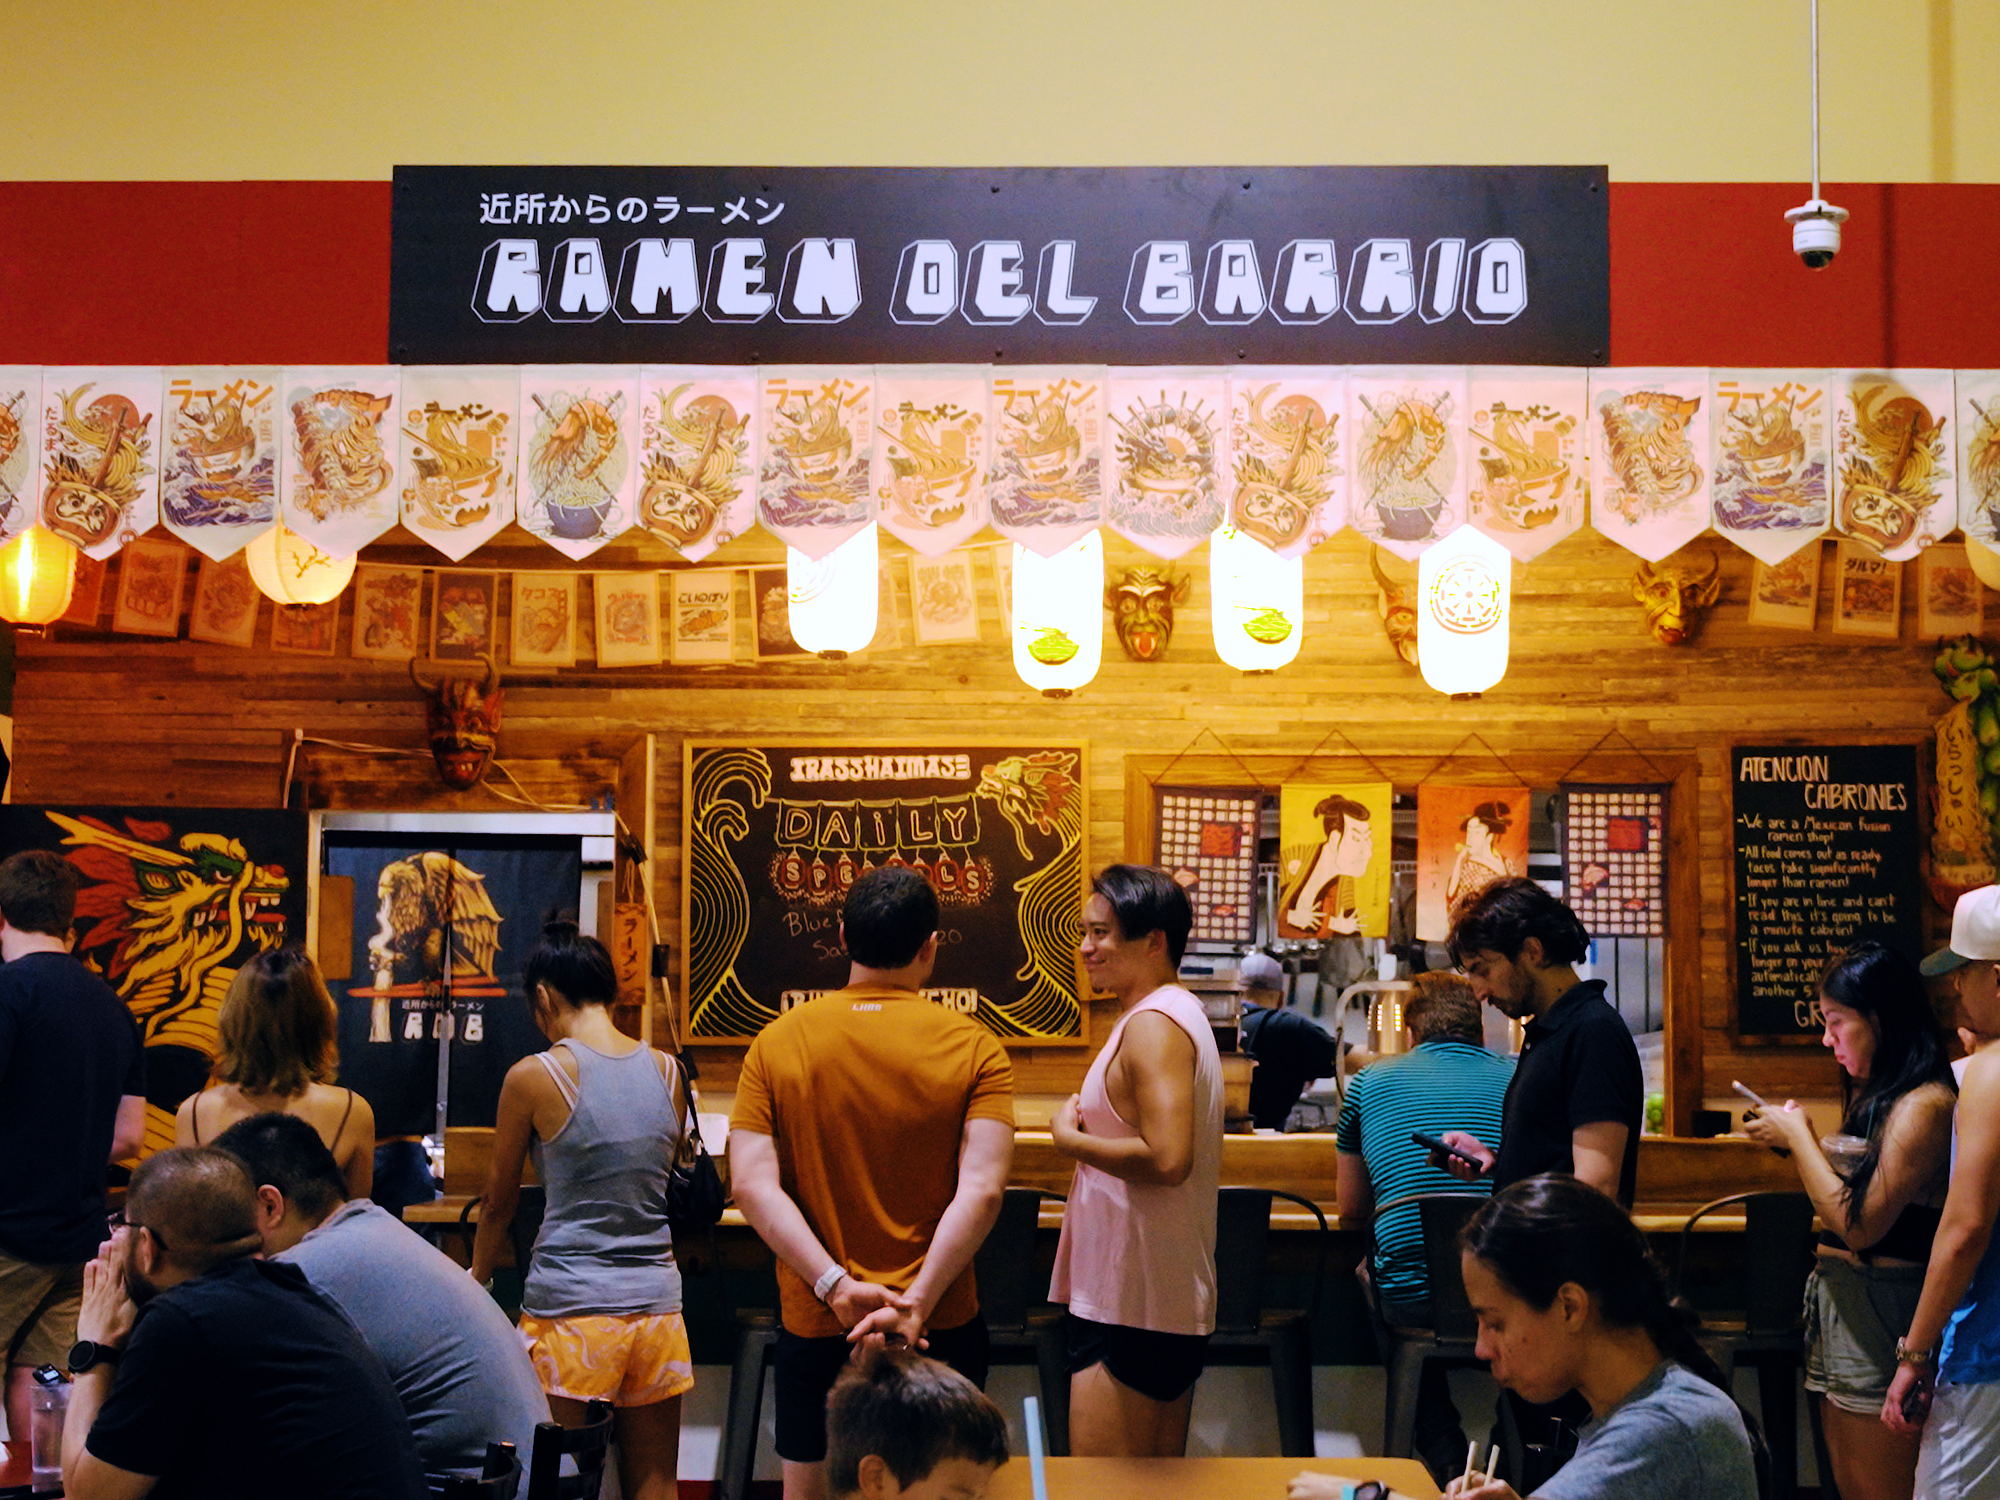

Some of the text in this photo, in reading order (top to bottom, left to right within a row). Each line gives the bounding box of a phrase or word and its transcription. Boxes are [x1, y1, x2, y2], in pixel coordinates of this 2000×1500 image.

[479, 193, 785, 224] 近所からのラーメン
[471, 237, 1528, 325] RAMEN DEL BARRIO
[169, 378, 274, 408] ラーメン
[766, 378, 870, 408] ラーメン
[993, 378, 1097, 409] ラーメン
[1717, 382, 1823, 412] ラーメン
[45, 406, 58, 451] だるま
[643, 405, 656, 450] だるま
[1232, 407, 1244, 451] だるま
[1836, 408, 1850, 453] だるま
[790, 754, 971, 782] IRASSHAIMASE
[1739, 755, 1829, 782] ATENCION
[1804, 783, 1907, 811] CABRONES
[1767, 818, 1786, 829] are
[1791, 819, 1800, 829] a
[1803, 815, 1853, 831] Mexican
[1767, 831, 1834, 845] ramen shop!
[1760, 846, 1781, 859] food
[1783, 849, 1812, 860] comes
[1816, 846, 1833, 860] out
[1835, 850, 1848, 861] as
[786, 862, 979, 889] SPELS
[1746, 875, 1849, 891] longer than ramen!
[1780, 860, 1803, 874] take
[1809, 861, 1877, 879] significantly
[1760, 897, 1779, 910] you
[1783, 896, 1800, 907] are
[1802, 897, 1813, 907] in
[1816, 893, 1837, 907] line
[1842, 894, 1863, 907] and
[1748, 908, 1776, 921] read
[1831, 911, 1862, 926] going
[1867, 909, 1878, 922] to
[1749, 925, 1758, 935] a
[1763, 923, 1803, 935] minute
[622, 918, 638, 982] ラーメン
[1760, 943, 1780, 955] you
[1783, 939, 1803, 953] ask
[1808, 943, 1822, 953] us
[1751, 954, 1824, 972] longer on your
[1752, 984, 1797, 997] another
